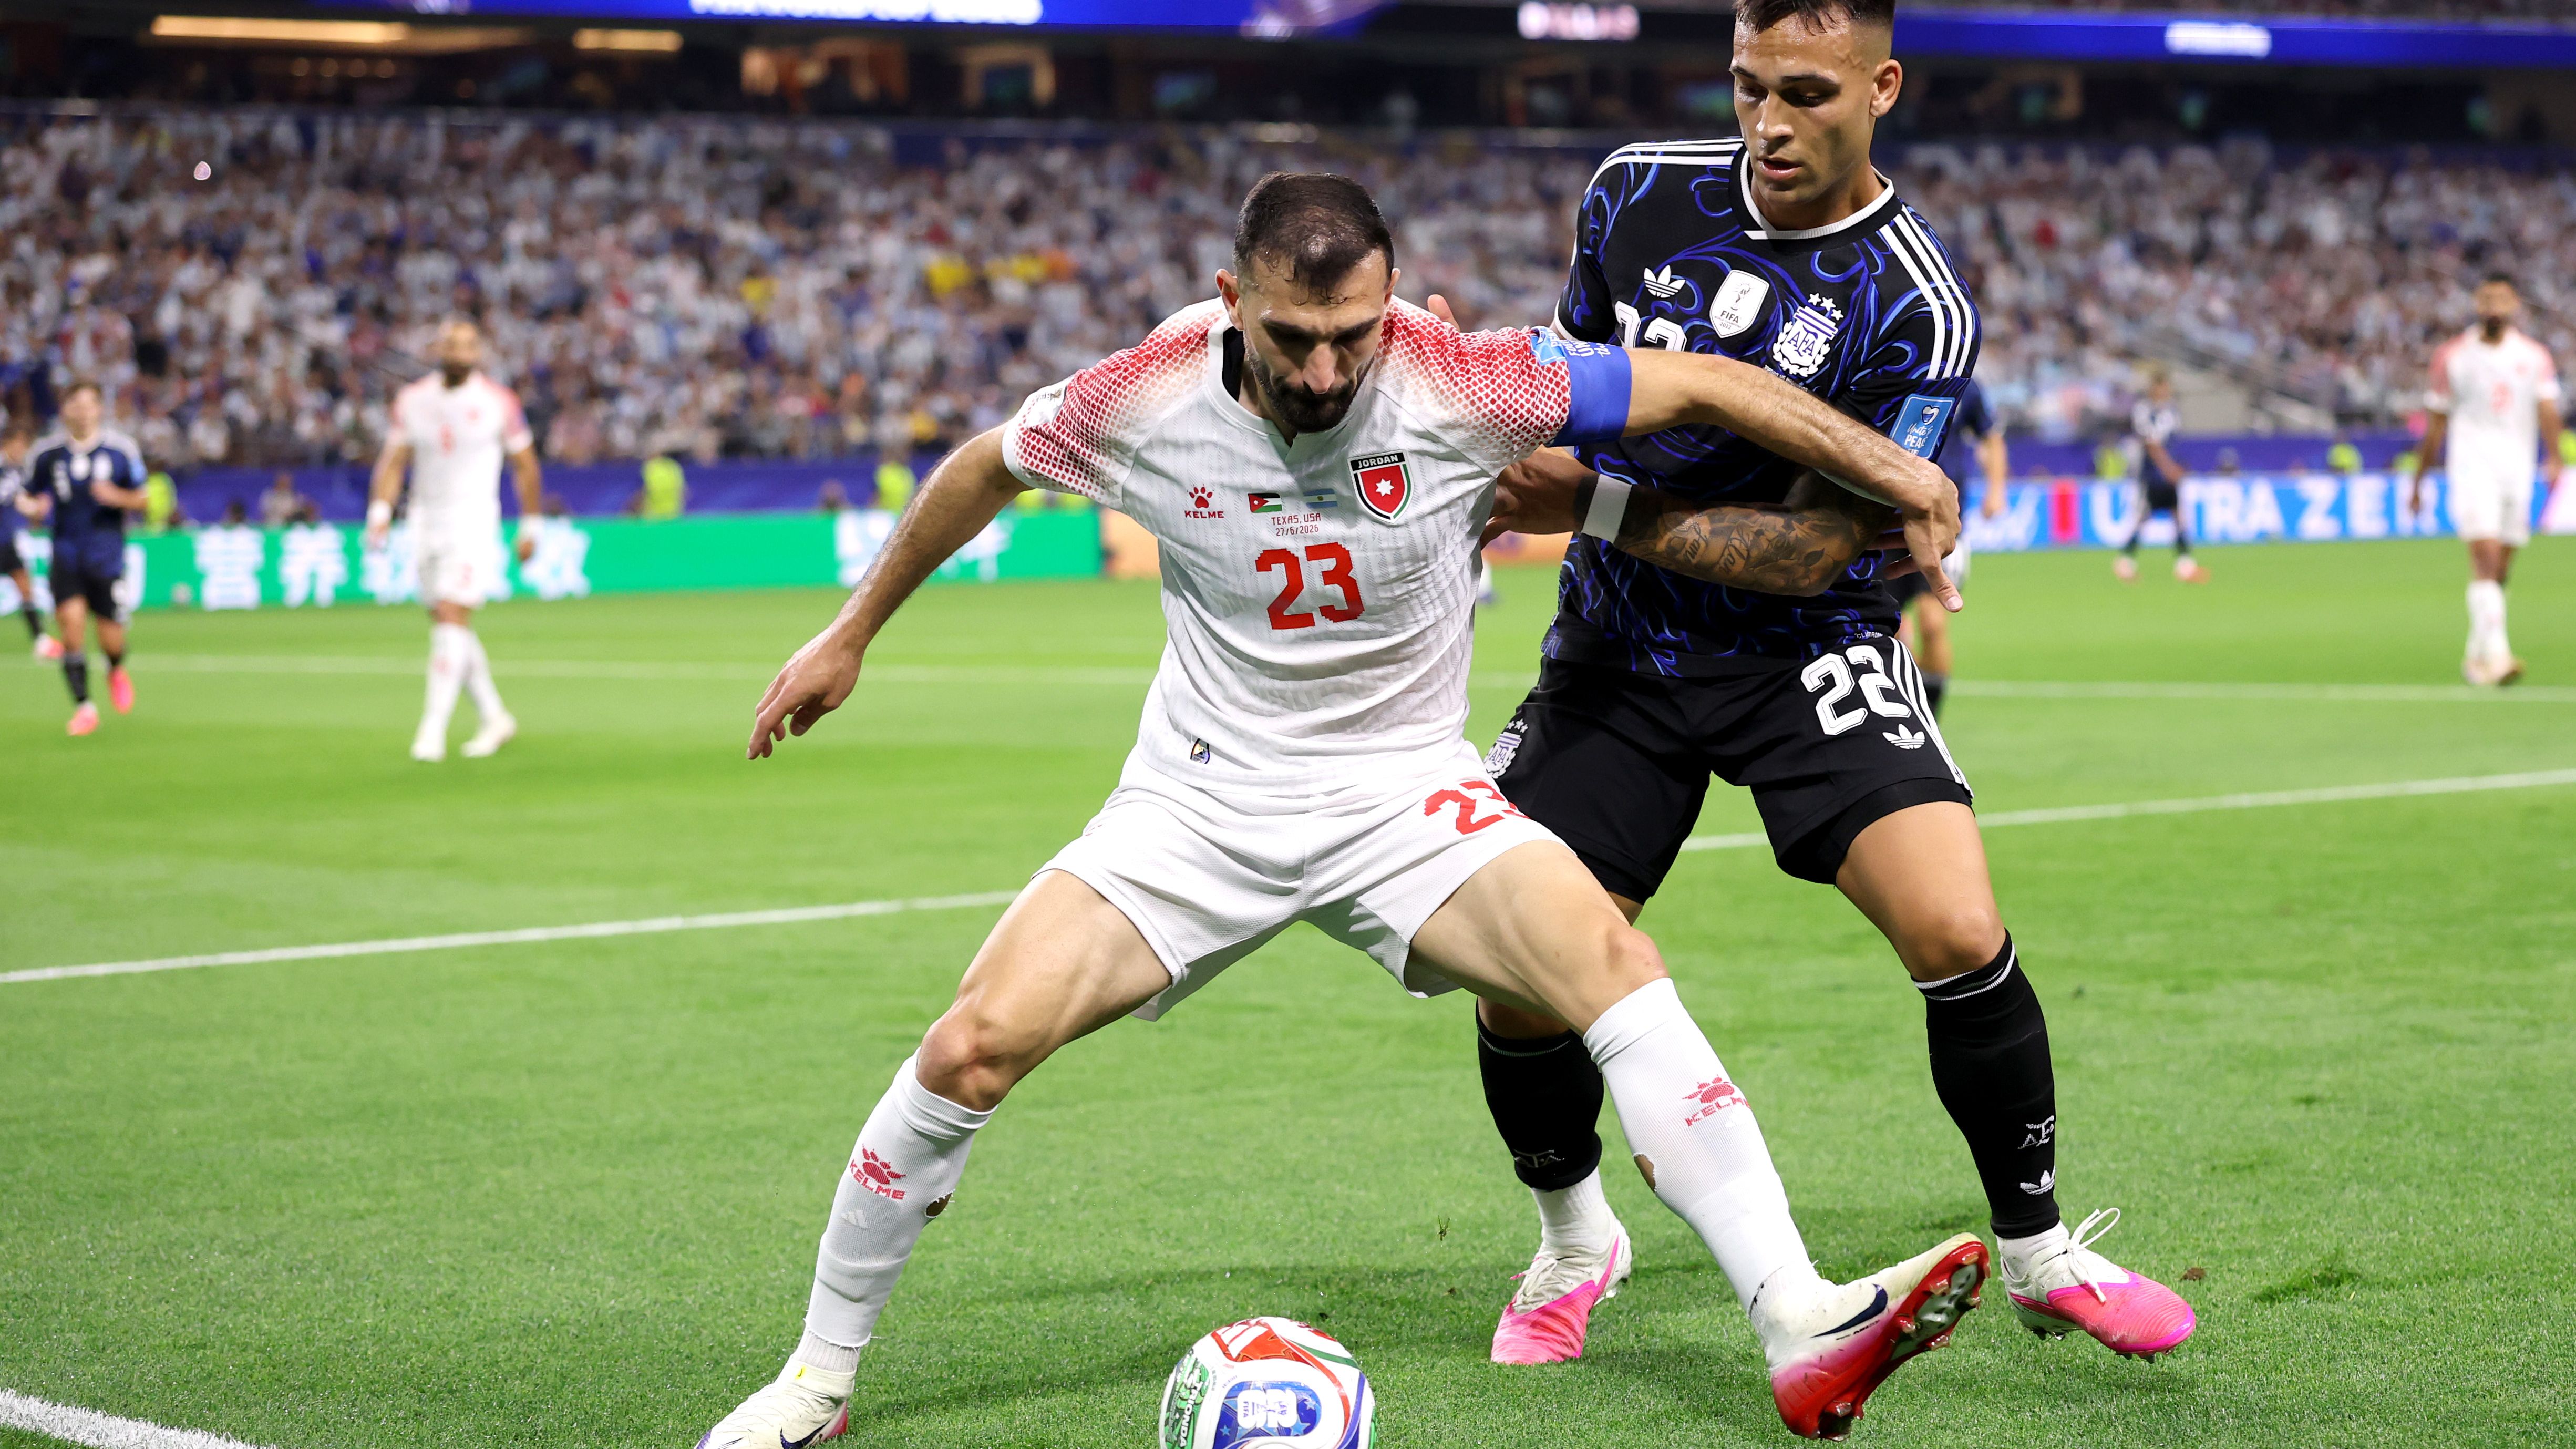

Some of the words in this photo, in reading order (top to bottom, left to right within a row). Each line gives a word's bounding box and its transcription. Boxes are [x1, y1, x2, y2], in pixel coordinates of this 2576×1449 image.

[1720, 310, 1739, 323] FIFA
[1787, 324, 1818, 357] AFA
[1357, 454, 1399, 469] JORDAN
[1184, 510, 1224, 519] KELME
[1271, 514, 1302, 526] TEXAS,
[1303, 512, 1322, 522] USA
[2295, 475, 2439, 539] ZER
[1275, 524, 1319, 537] 27/6/2026
[1255, 542, 1365, 630] 23
[1800, 645, 1912, 736] 22
[1685, 1096, 1751, 1127] KELM
[849, 1158, 906, 1200] KELME
[1180, 1381, 1203, 1447] TRIONDA
